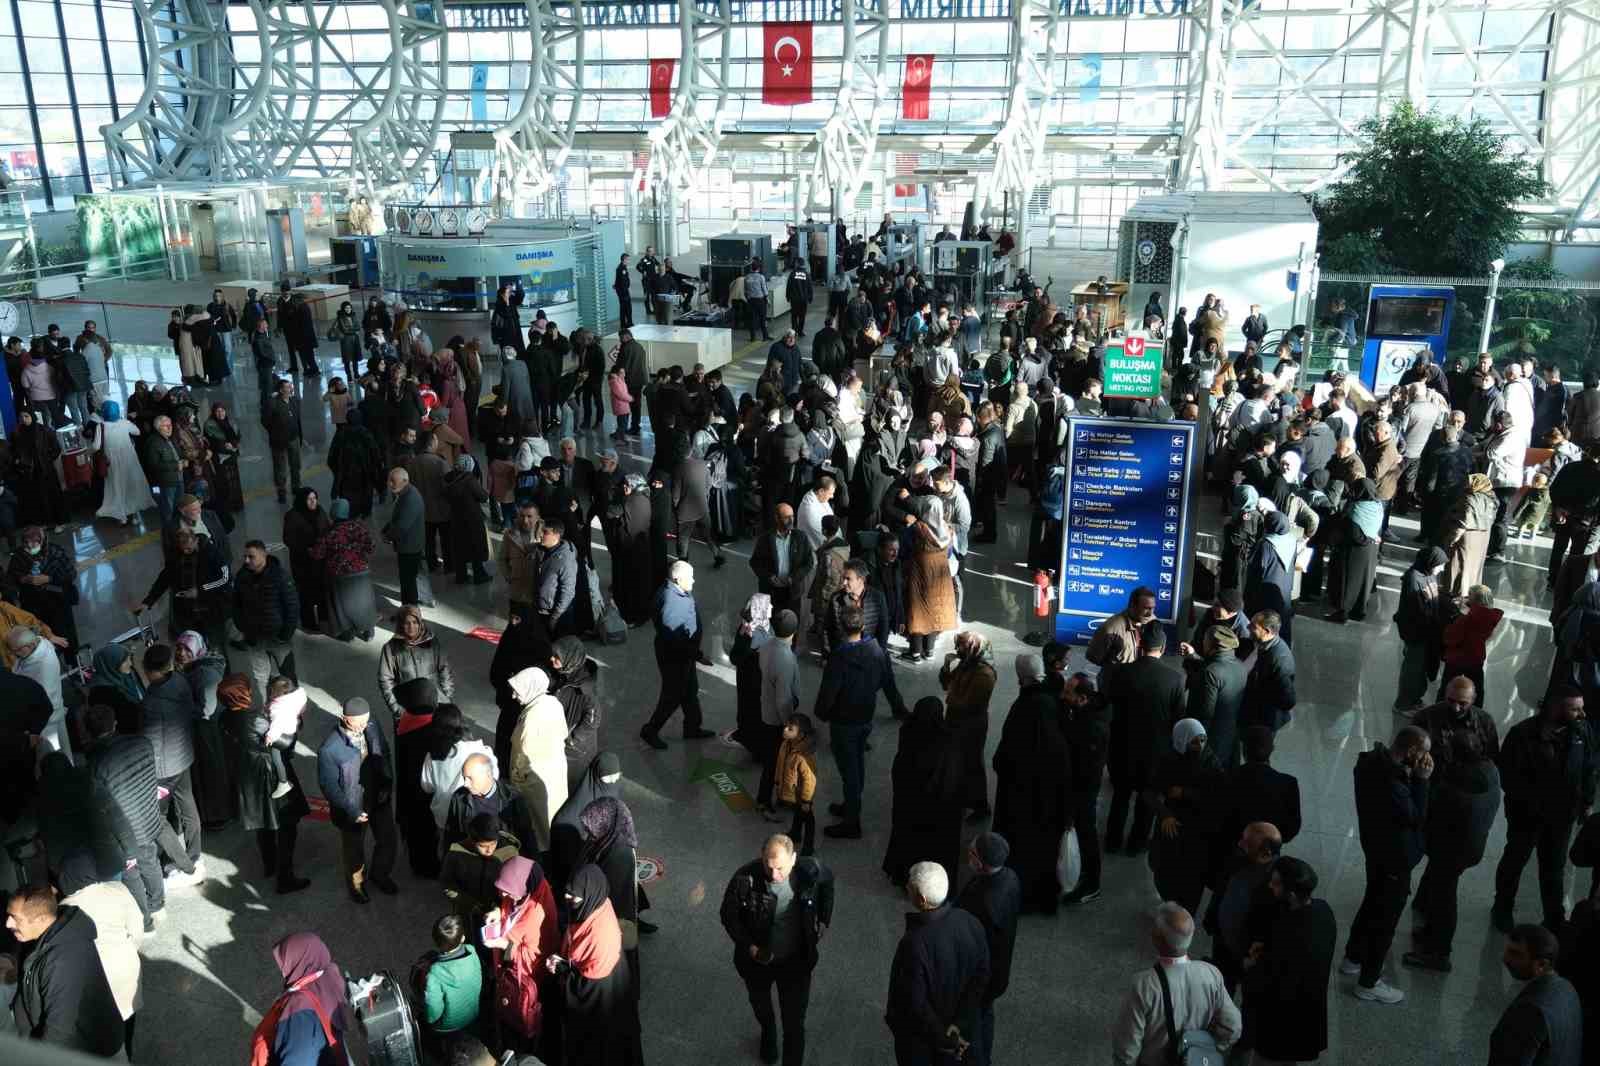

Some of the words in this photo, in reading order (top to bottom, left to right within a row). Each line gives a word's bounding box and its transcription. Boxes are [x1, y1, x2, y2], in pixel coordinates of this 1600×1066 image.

[407, 254, 447, 264] DANIŞMA
[515, 250, 554, 261] DANIŞMA
[1109, 359, 1156, 371] BULUŞMA
[1112, 373, 1151, 384] NOKTASI
[1109, 384, 1135, 392] MEETING
[1136, 385, 1153, 393] POINT
